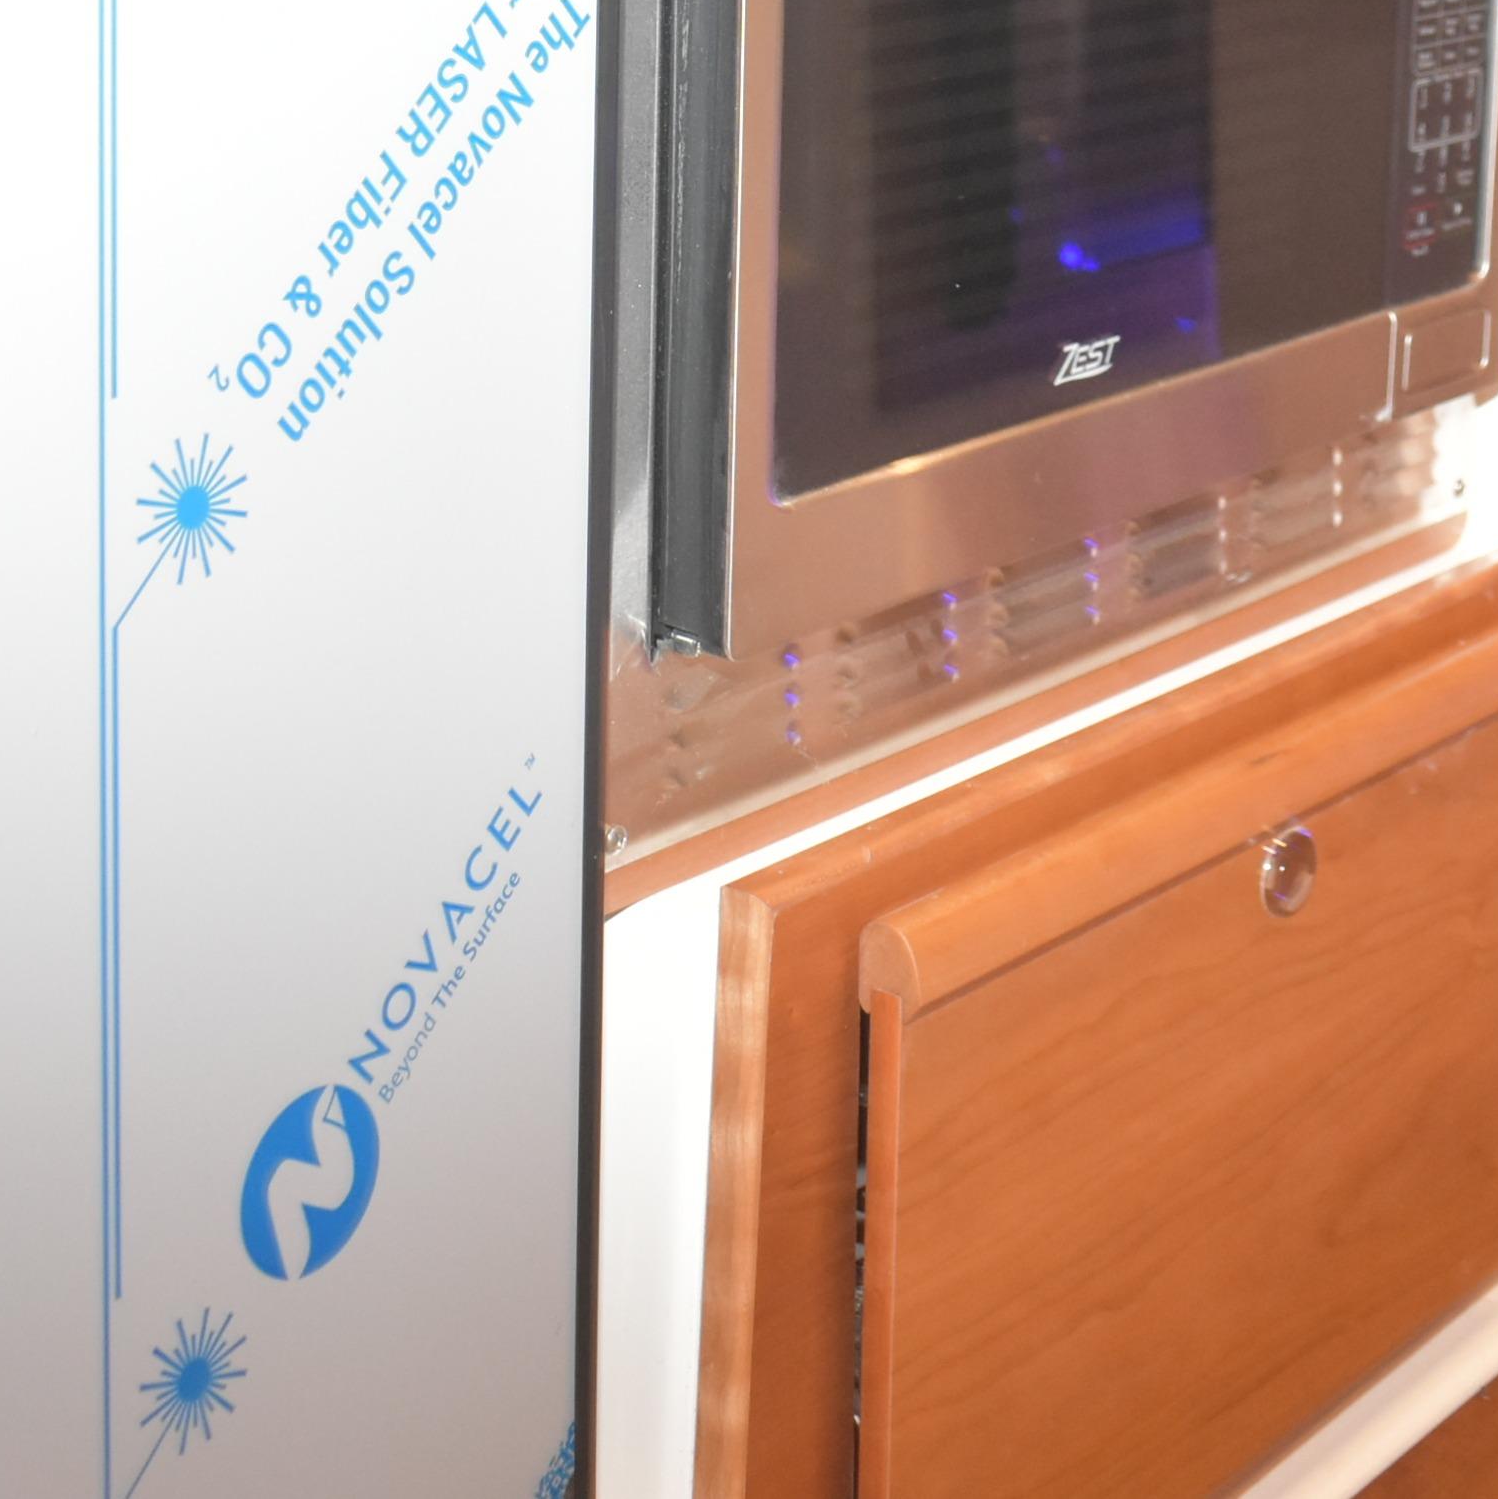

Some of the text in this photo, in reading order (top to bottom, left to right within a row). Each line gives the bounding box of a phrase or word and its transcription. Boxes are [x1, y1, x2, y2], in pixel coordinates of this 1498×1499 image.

[396, 2, 508, 158] LASER
[407, 71, 535, 261] Novacel
[284, 274, 323, 318] &
[317, 150, 408, 277] Fiber
[277, 250, 417, 442] Solution
[1053, 335, 1121, 387] ZEST
[347, 785, 543, 1084] NOVACEL
[377, 870, 521, 1104] Beyond The Surface
